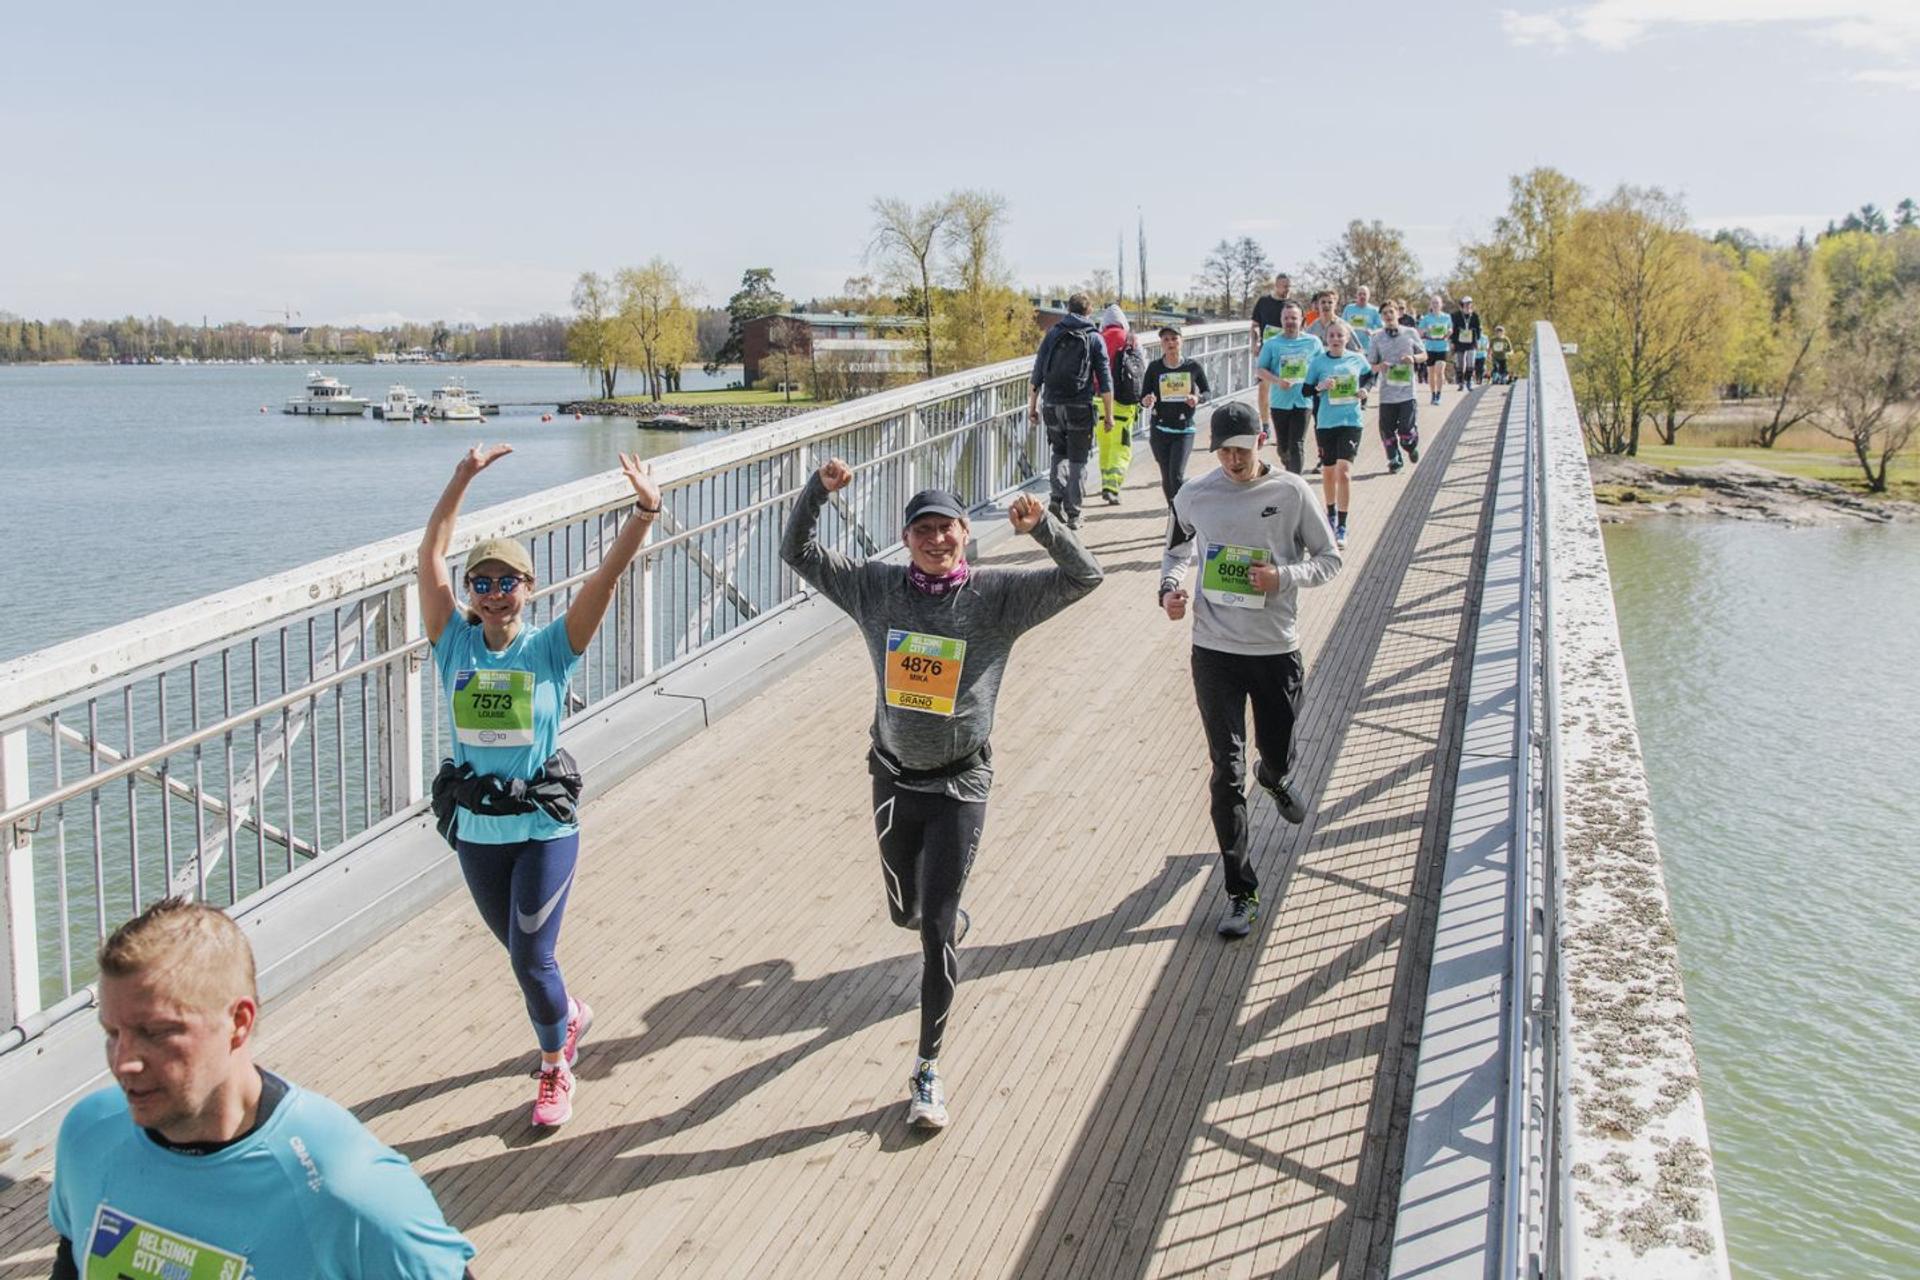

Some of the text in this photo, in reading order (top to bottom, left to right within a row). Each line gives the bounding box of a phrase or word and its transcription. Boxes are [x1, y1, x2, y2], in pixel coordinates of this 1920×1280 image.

[900, 656, 942, 676] 4876
[472, 693, 513, 710] 7573
[137, 1229, 199, 1268] HELSINKI
